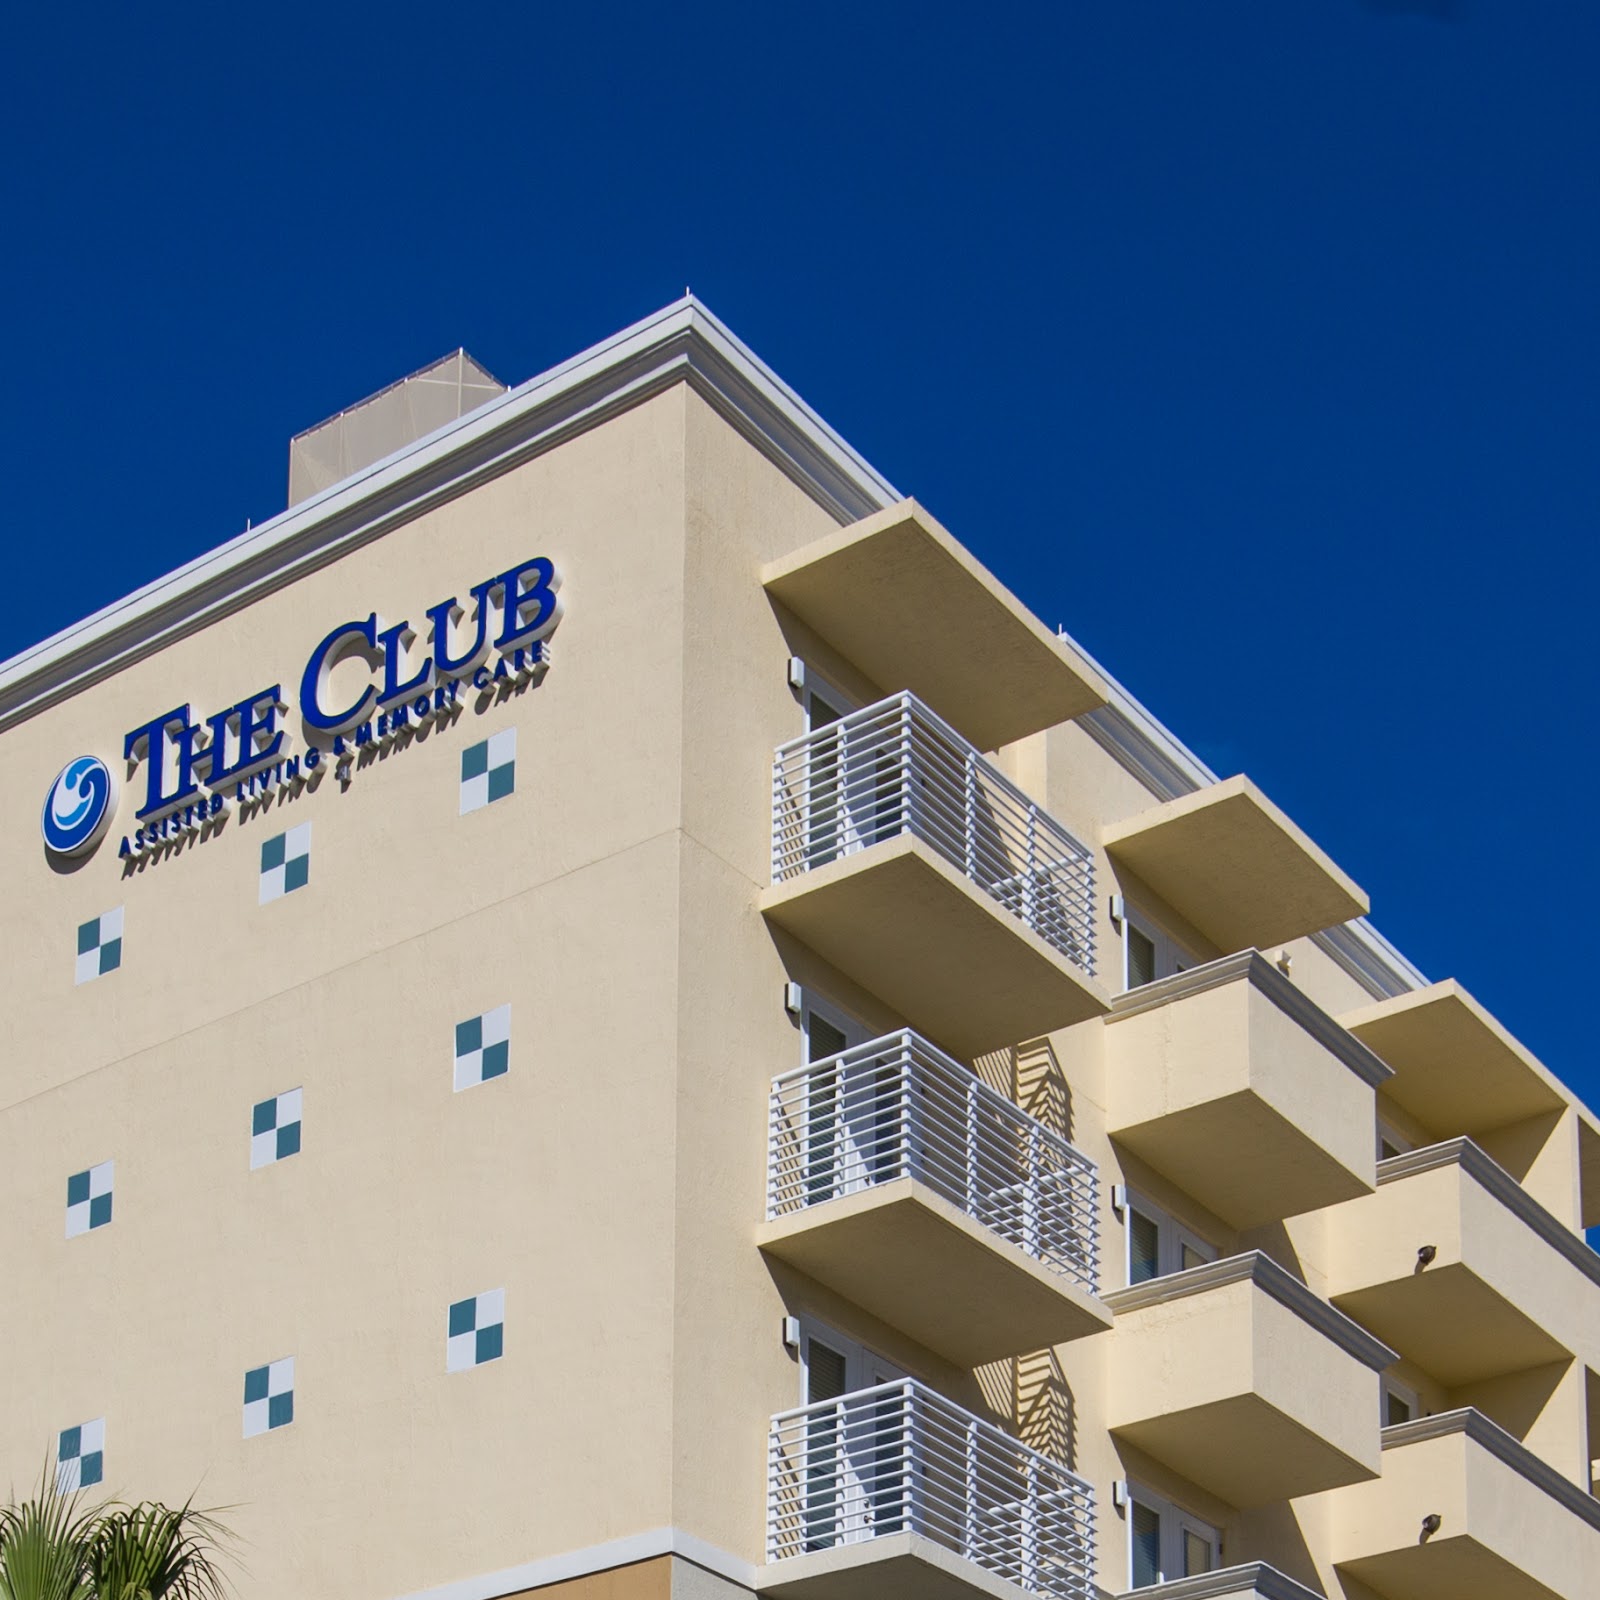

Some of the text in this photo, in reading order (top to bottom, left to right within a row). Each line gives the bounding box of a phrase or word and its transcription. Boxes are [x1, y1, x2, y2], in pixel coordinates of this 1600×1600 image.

[118, 793, 224, 859] ASSISTED
[237, 747, 321, 803] LIVING
[355, 679, 460, 747] MEMORY
[473, 640, 543, 690] CARE
[124, 556, 557, 820] THE CLUB
